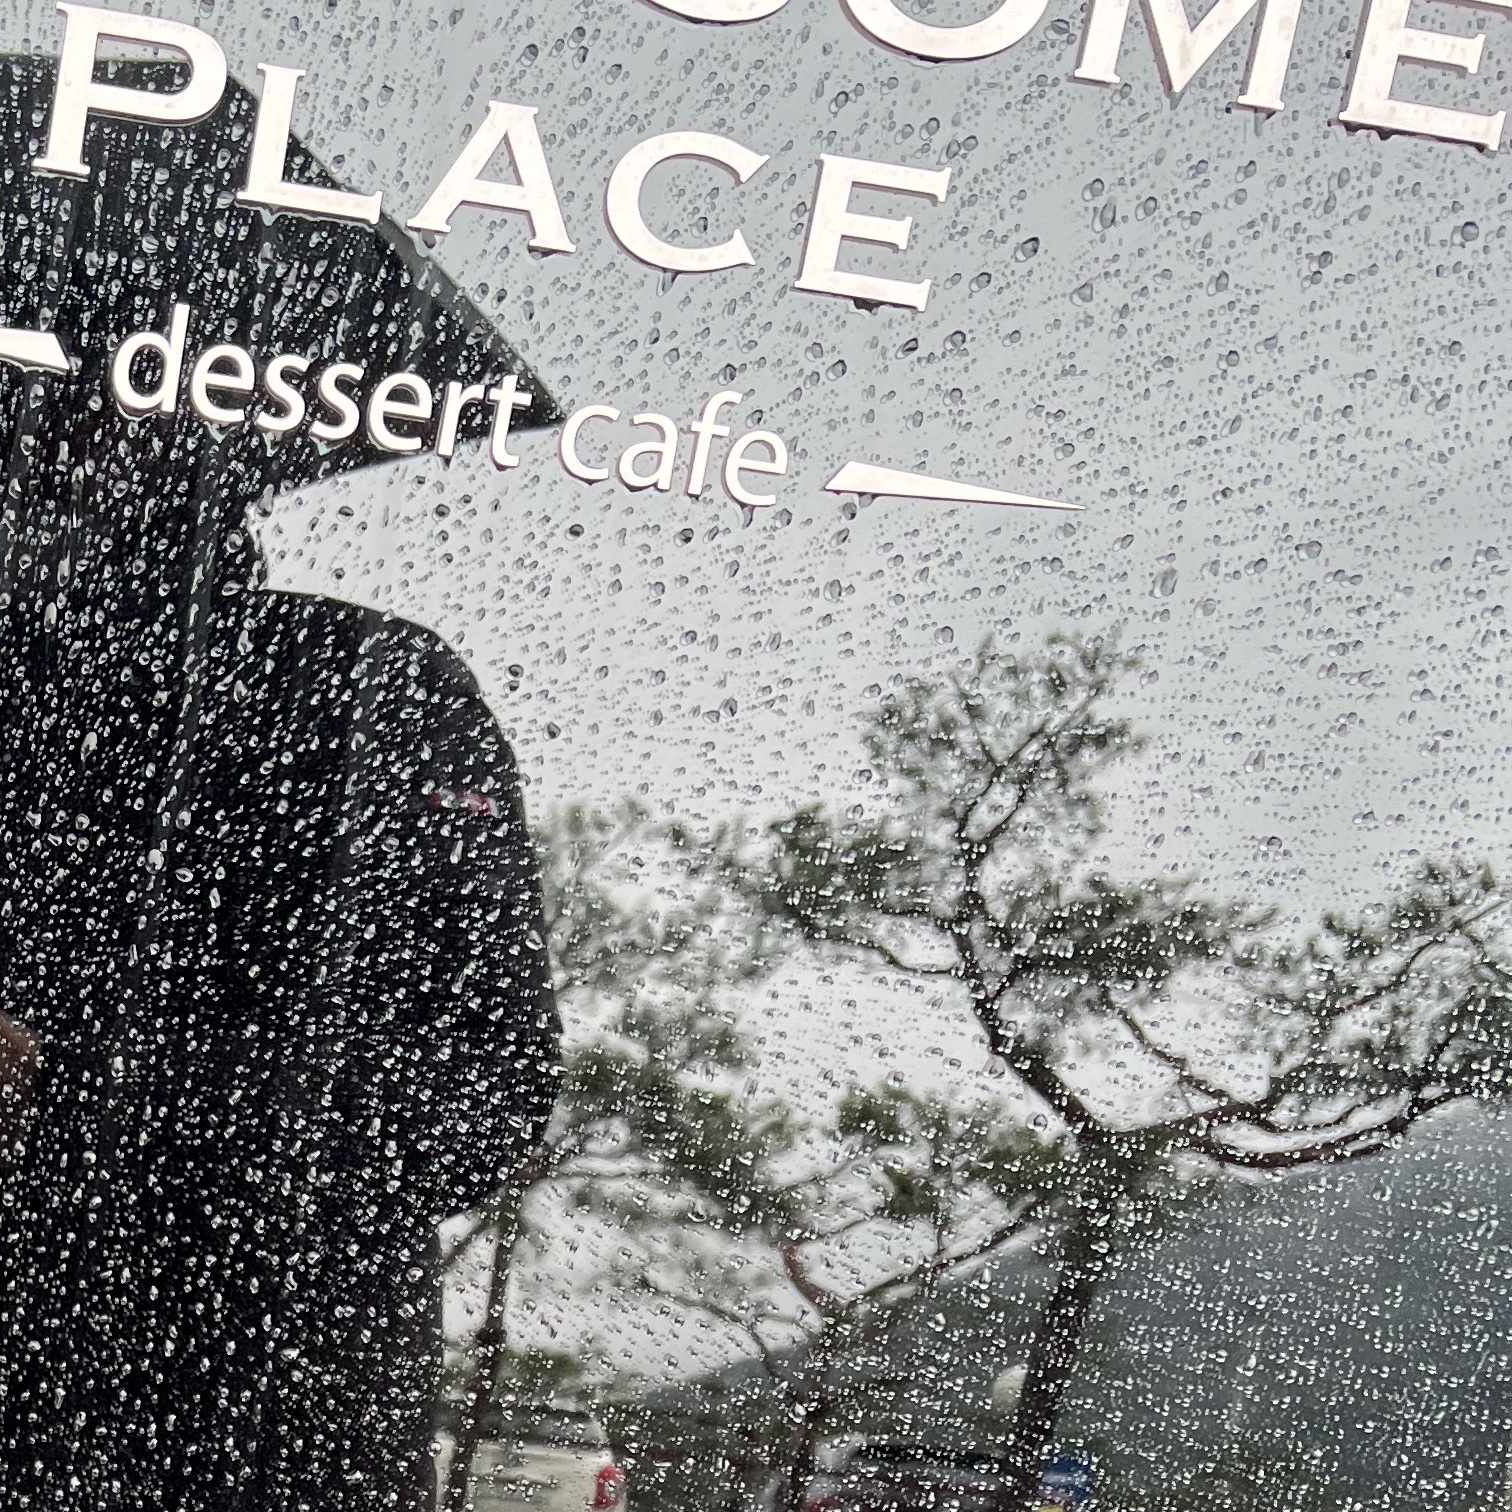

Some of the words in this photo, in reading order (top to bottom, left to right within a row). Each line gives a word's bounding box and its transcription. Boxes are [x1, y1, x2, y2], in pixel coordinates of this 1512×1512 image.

[33, 1, 952, 312] PLACE
[113, 303, 534, 468] dessert
[559, 390, 789, 507] cafe
